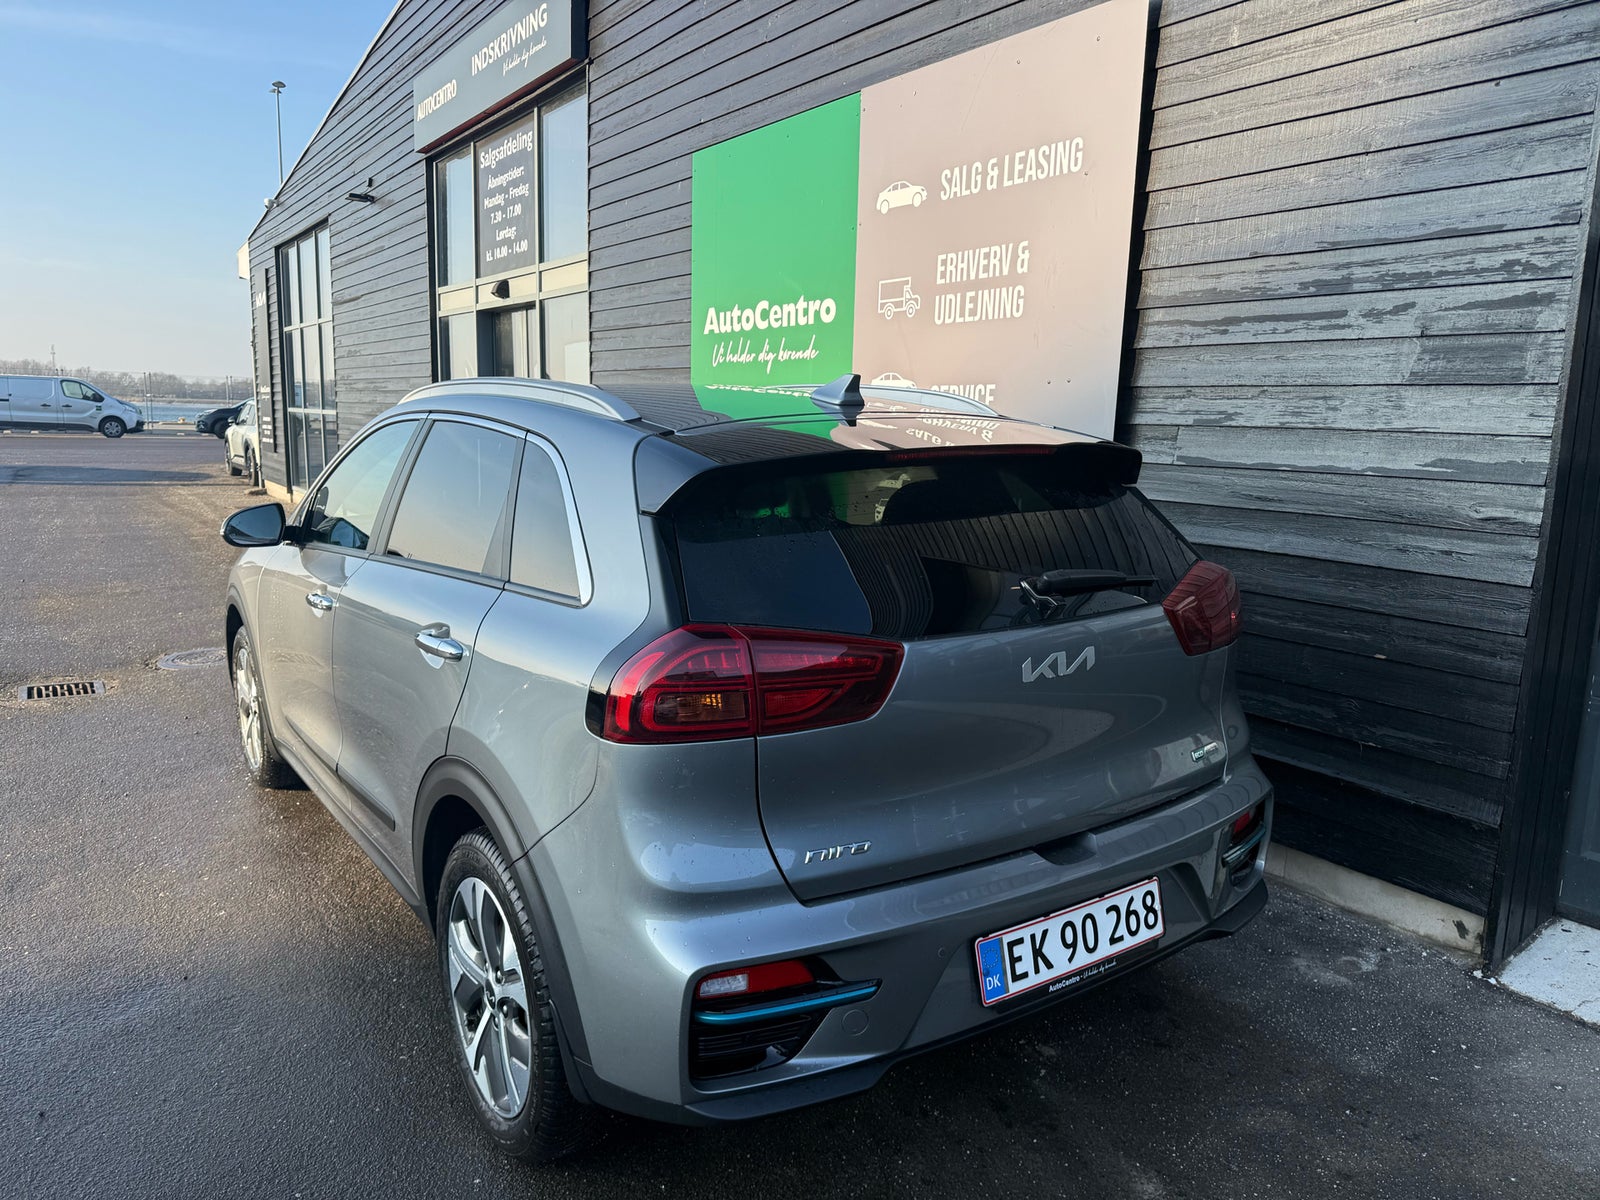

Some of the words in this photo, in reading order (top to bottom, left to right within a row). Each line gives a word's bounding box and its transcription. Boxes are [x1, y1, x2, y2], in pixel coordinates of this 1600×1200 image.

[471, 3, 548, 76] INDSKRIVNING
[417, 79, 457, 122] AUTOCENTRO
[480, 130, 533, 169] Salgsafdeling
[940, 161, 983, 201] SALG
[986, 157, 999, 191] &
[1003, 136, 1084, 187] LEASING
[484, 193, 505, 209] Mandag
[509, 183, 529, 199] Fredag
[490, 210, 502, 225] 7.30
[507, 203, 522, 219] 17.00
[936, 243, 1013, 285] ERHVERV
[1017, 240, 1030, 274] &
[703, 294, 837, 335] AutoCentro
[934, 285, 1025, 325] UDLEJNING
[712, 342, 724, 367] Vi
[726, 337, 756, 364] holder
[758, 338, 777, 374] dig
[777, 334, 819, 362] kørende
[1022, 645, 1095, 683] KIA
[804, 840, 872, 864] niro
[1007, 928, 1054, 983] EK
[1060, 913, 1099, 964] 90
[1106, 890, 1158, 946] 268
[986, 974, 1001, 991] DK
[1049, 975, 1080, 993] AutoCentro
